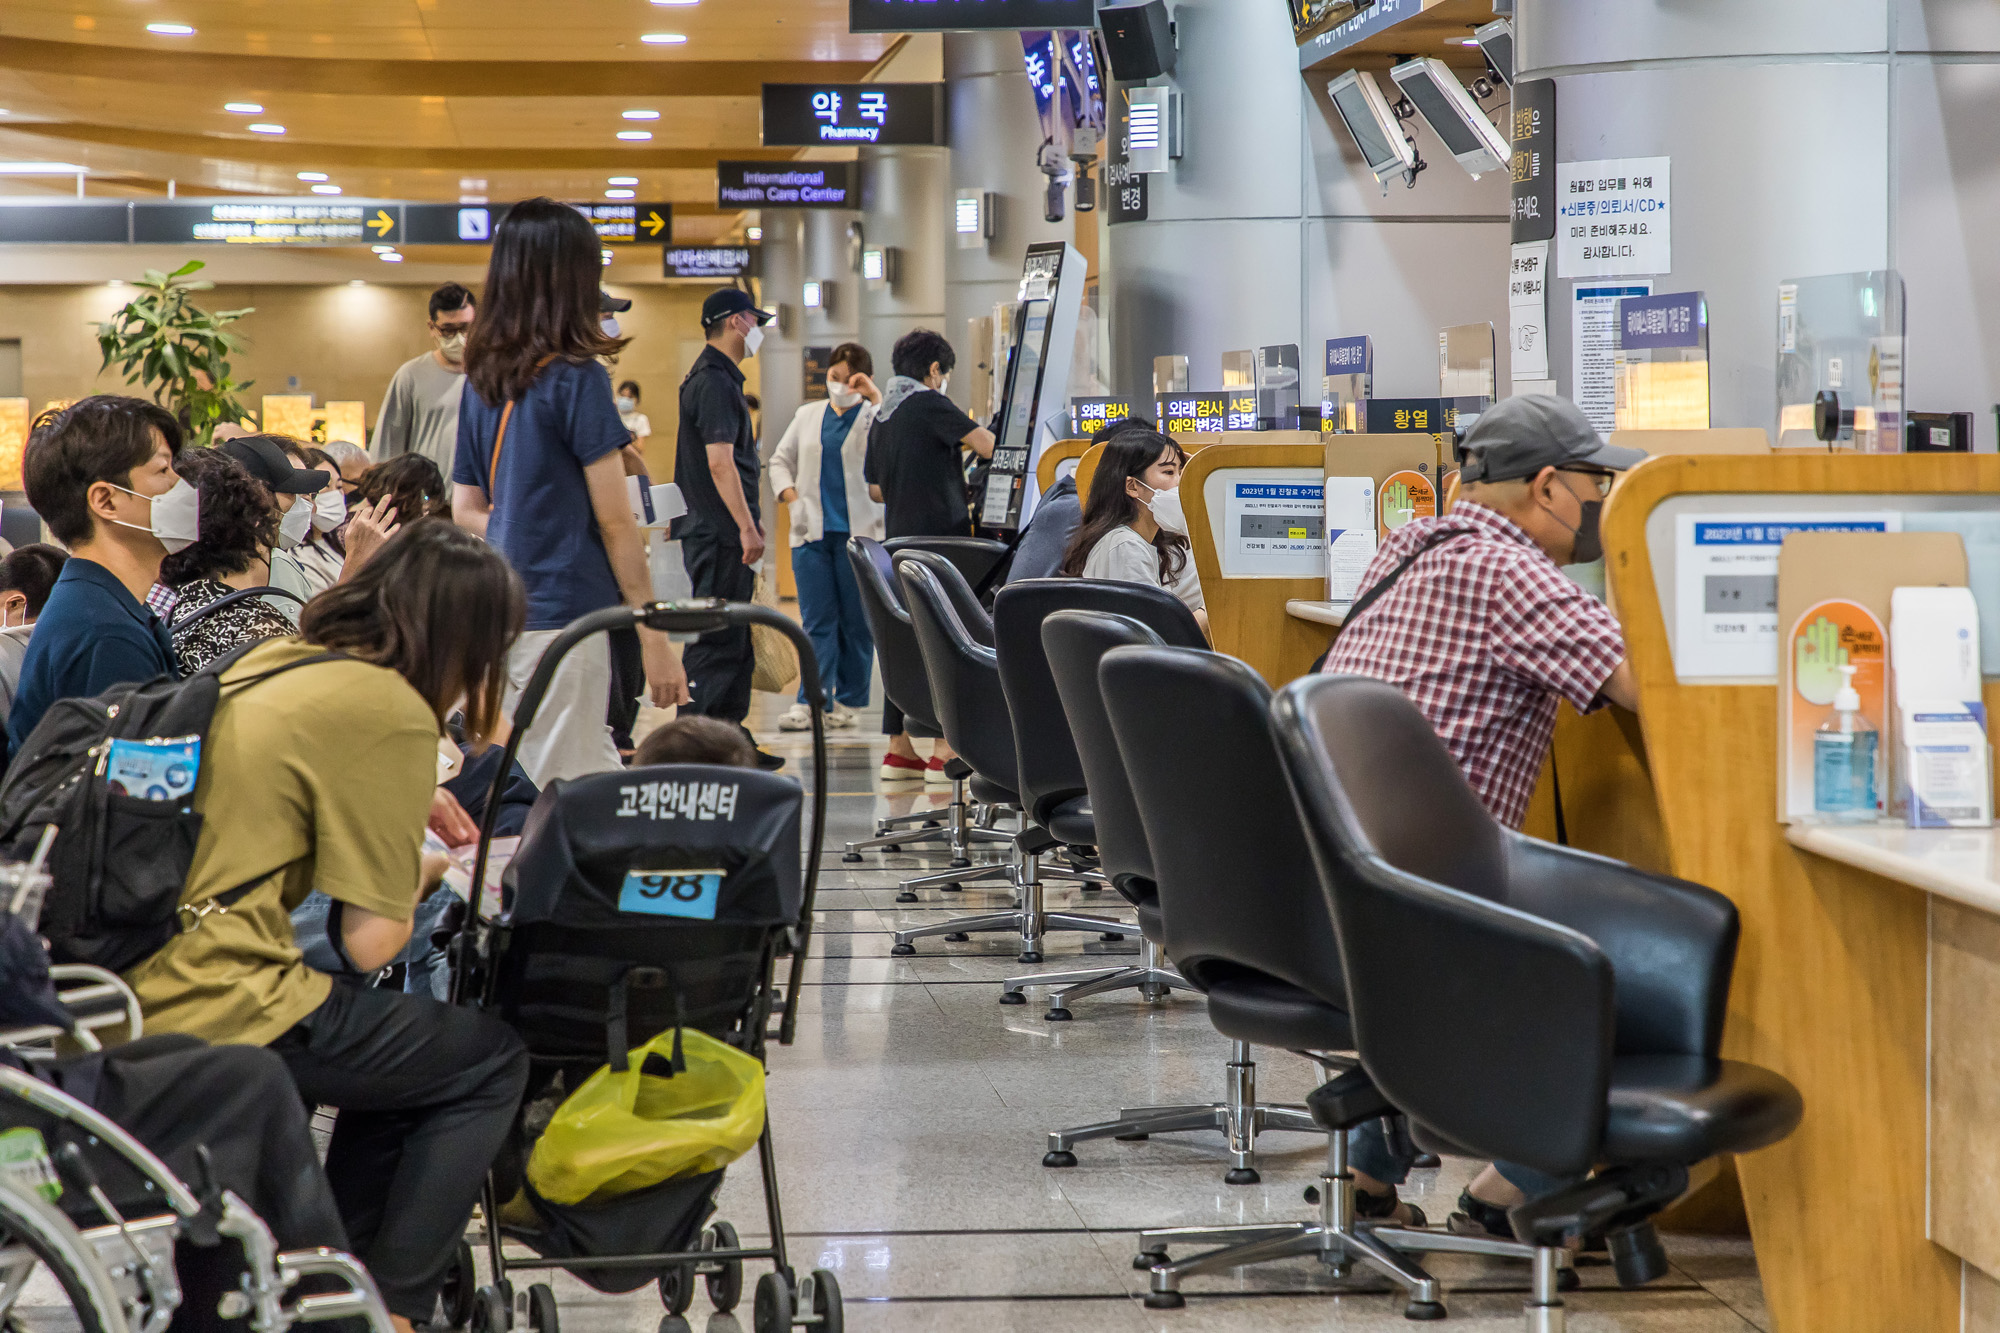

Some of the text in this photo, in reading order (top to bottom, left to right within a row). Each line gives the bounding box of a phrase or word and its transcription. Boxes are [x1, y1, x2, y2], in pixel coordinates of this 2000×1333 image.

[820, 125, 879, 142] Pharmacy
[743, 170, 824, 186] International
[1570, 176, 1653, 193] 원활한 업무를 위해
[721, 187, 846, 202] Health Care Center
[1121, 187, 1141, 210] 변경
[1571, 222, 1652, 238] 미리 준비해주세요.
[1583, 245, 1635, 259] 감사합니다.
[1081, 402, 1129, 419] 외래검사
[1168, 400, 1225, 418] 외래검사
[1168, 417, 1225, 433] 예약변경
[1241, 487, 1264, 496] 2023년
[1266, 487, 1276, 496] 1월
[1279, 488, 1299, 496] 진찰료
[616, 780, 739, 822] 고객안내센터
[638, 874, 704, 902] 98
